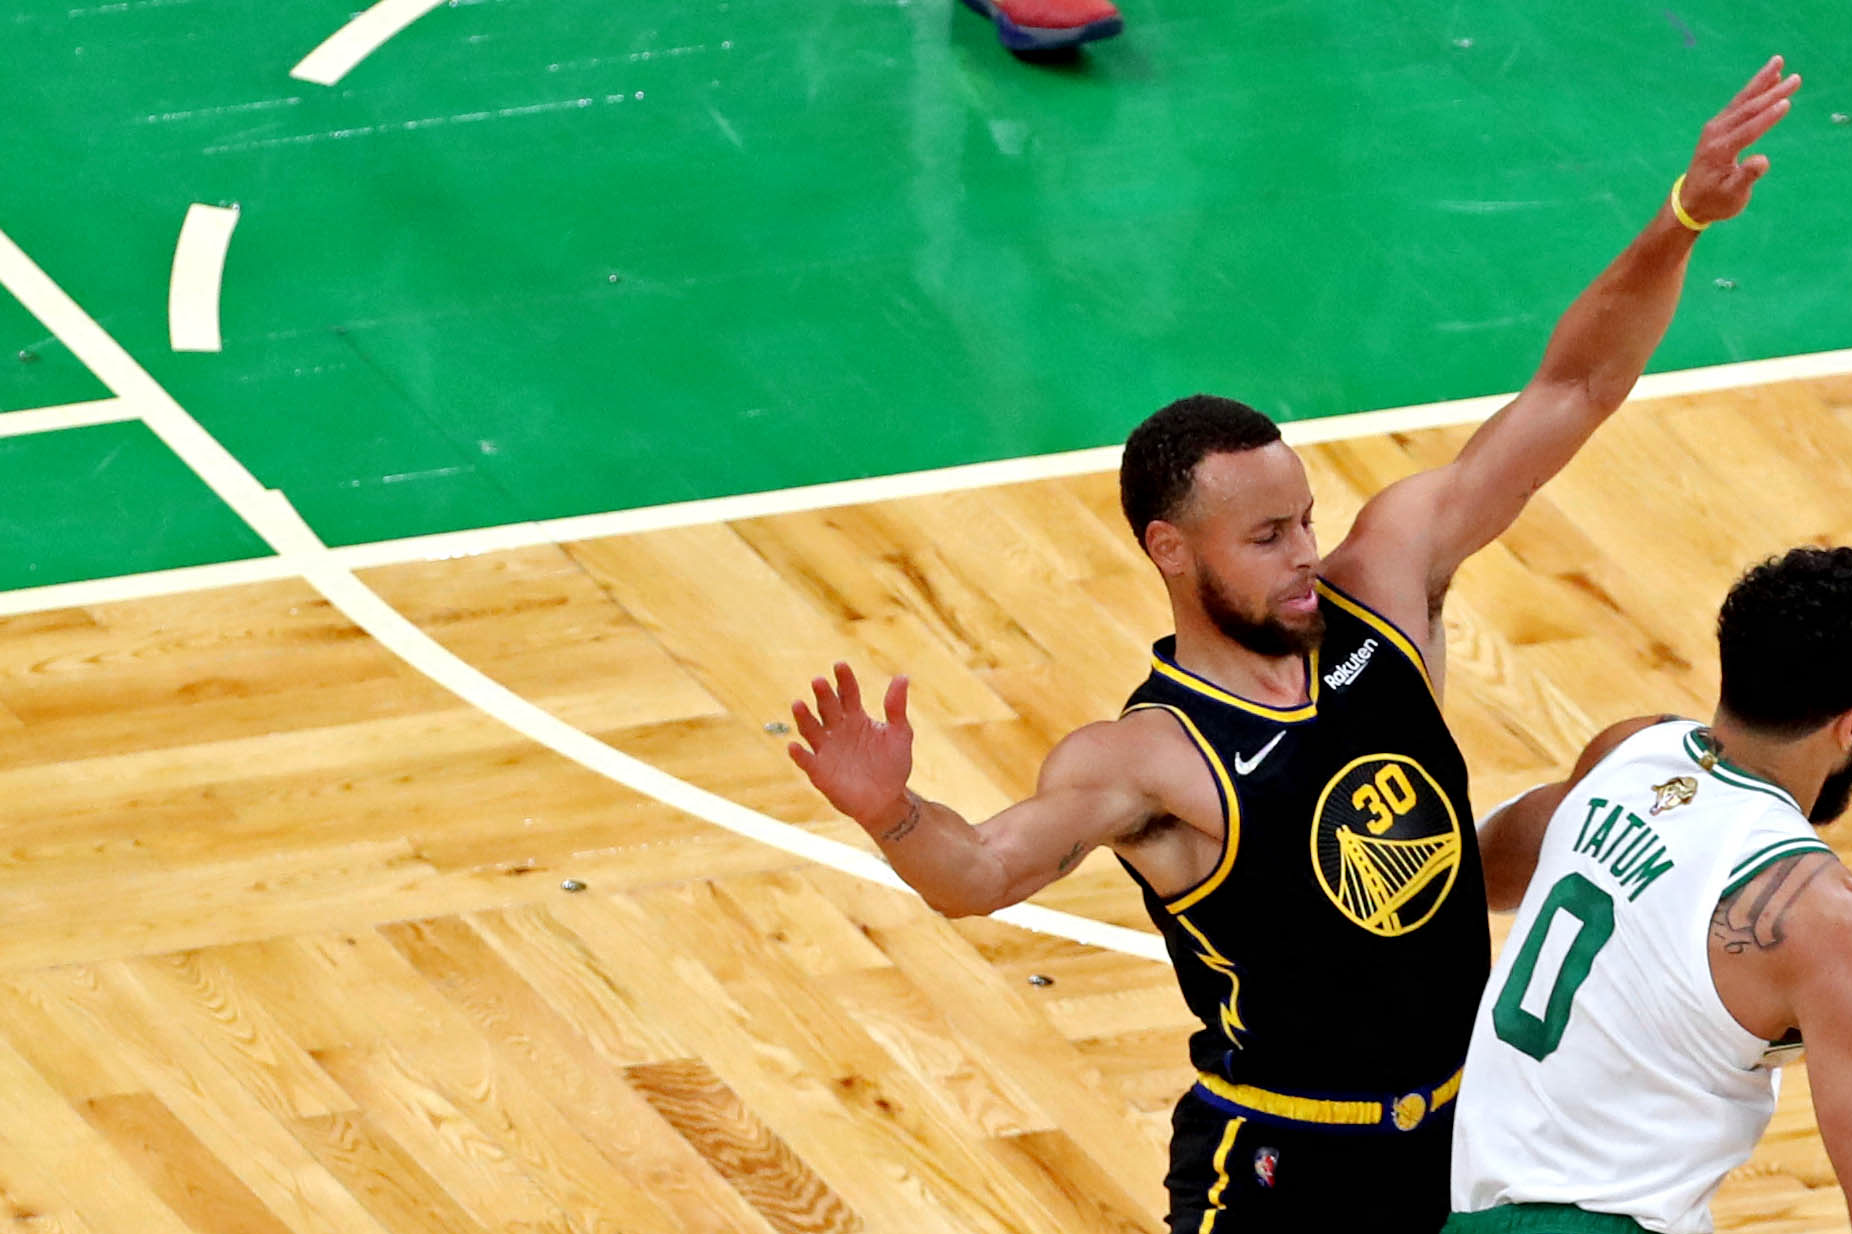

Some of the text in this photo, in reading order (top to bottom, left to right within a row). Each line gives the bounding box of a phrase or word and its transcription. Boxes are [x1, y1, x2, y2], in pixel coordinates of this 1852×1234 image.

[1323, 638, 1379, 690] Rakuten
[1352, 763, 1417, 836] 30
[1573, 797, 1675, 902] TATUM
[1492, 871, 1615, 1062] 0
